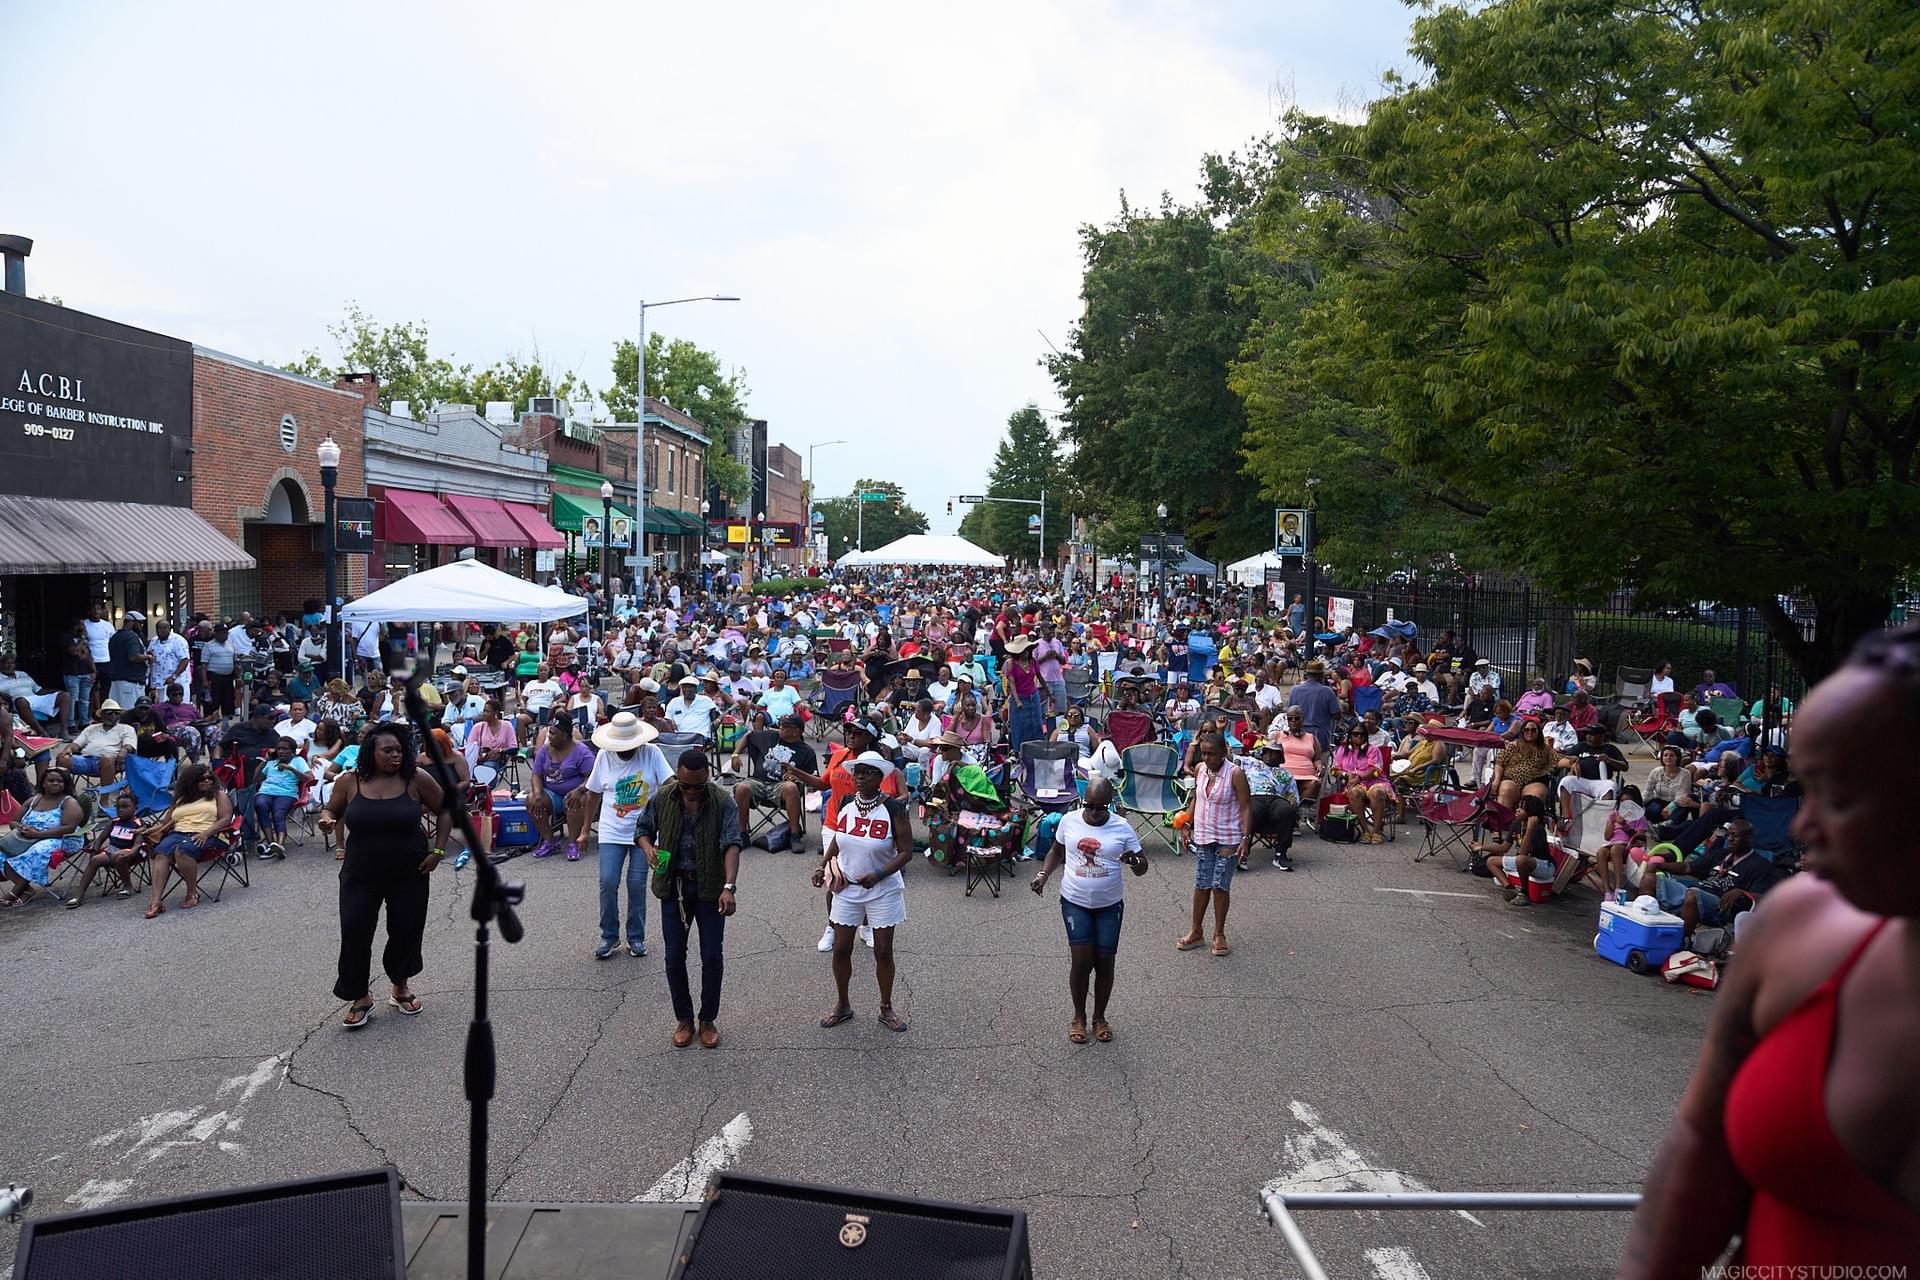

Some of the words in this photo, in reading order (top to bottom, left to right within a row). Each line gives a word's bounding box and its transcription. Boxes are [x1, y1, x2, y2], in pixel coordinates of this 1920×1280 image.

[18, 369, 86, 402] A.C.B.I.
[24, 423, 74, 441] 909-0127
[28, 402, 43, 415] OF
[46, 405, 85, 422] BARBER
[88, 411, 146, 431] INSTRUCTION
[149, 421, 163, 434] INC
